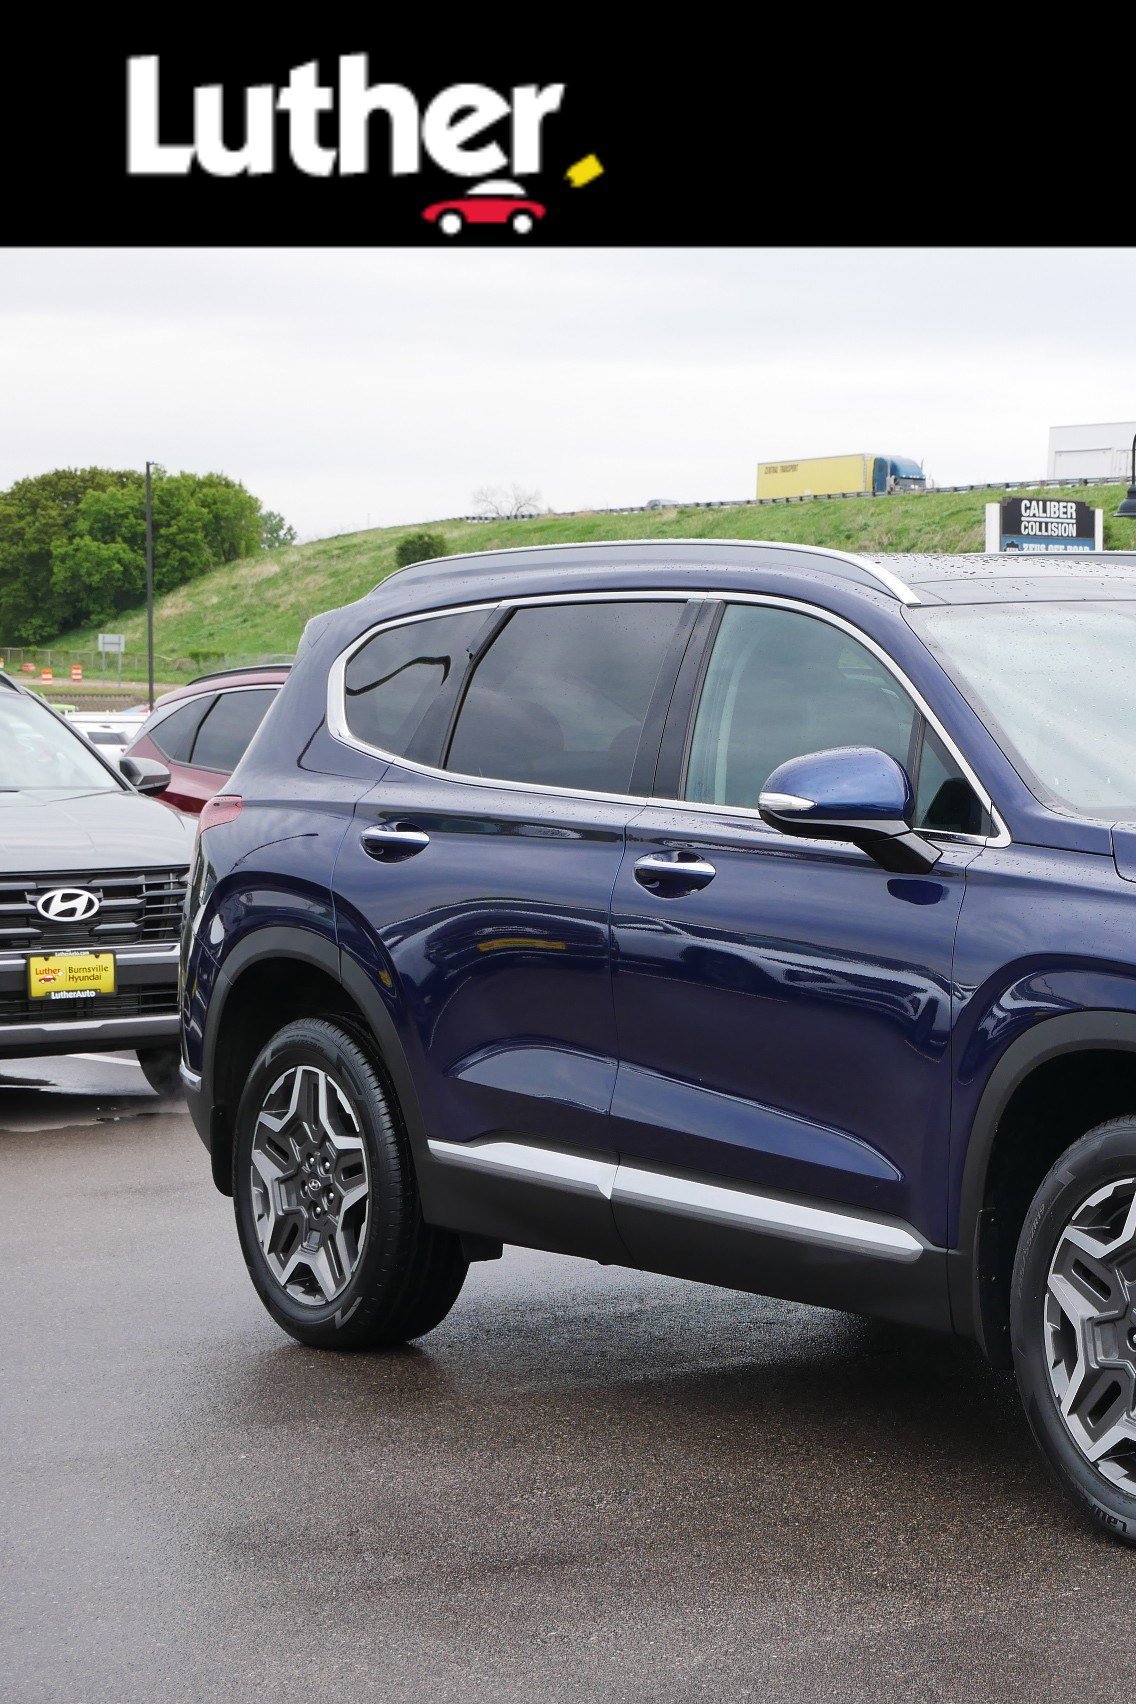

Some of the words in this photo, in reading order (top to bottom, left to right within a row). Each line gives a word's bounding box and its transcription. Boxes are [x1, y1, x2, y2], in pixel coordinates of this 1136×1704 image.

[1021, 500, 1077, 518] CALIBER
[1021, 521, 1077, 537] COLLISION
[35, 967, 61, 976] Luther
[68, 965, 109, 974] Burnsville
[68, 974, 102, 983] Hyundai
[51, 990, 96, 1000] LutherAuto
